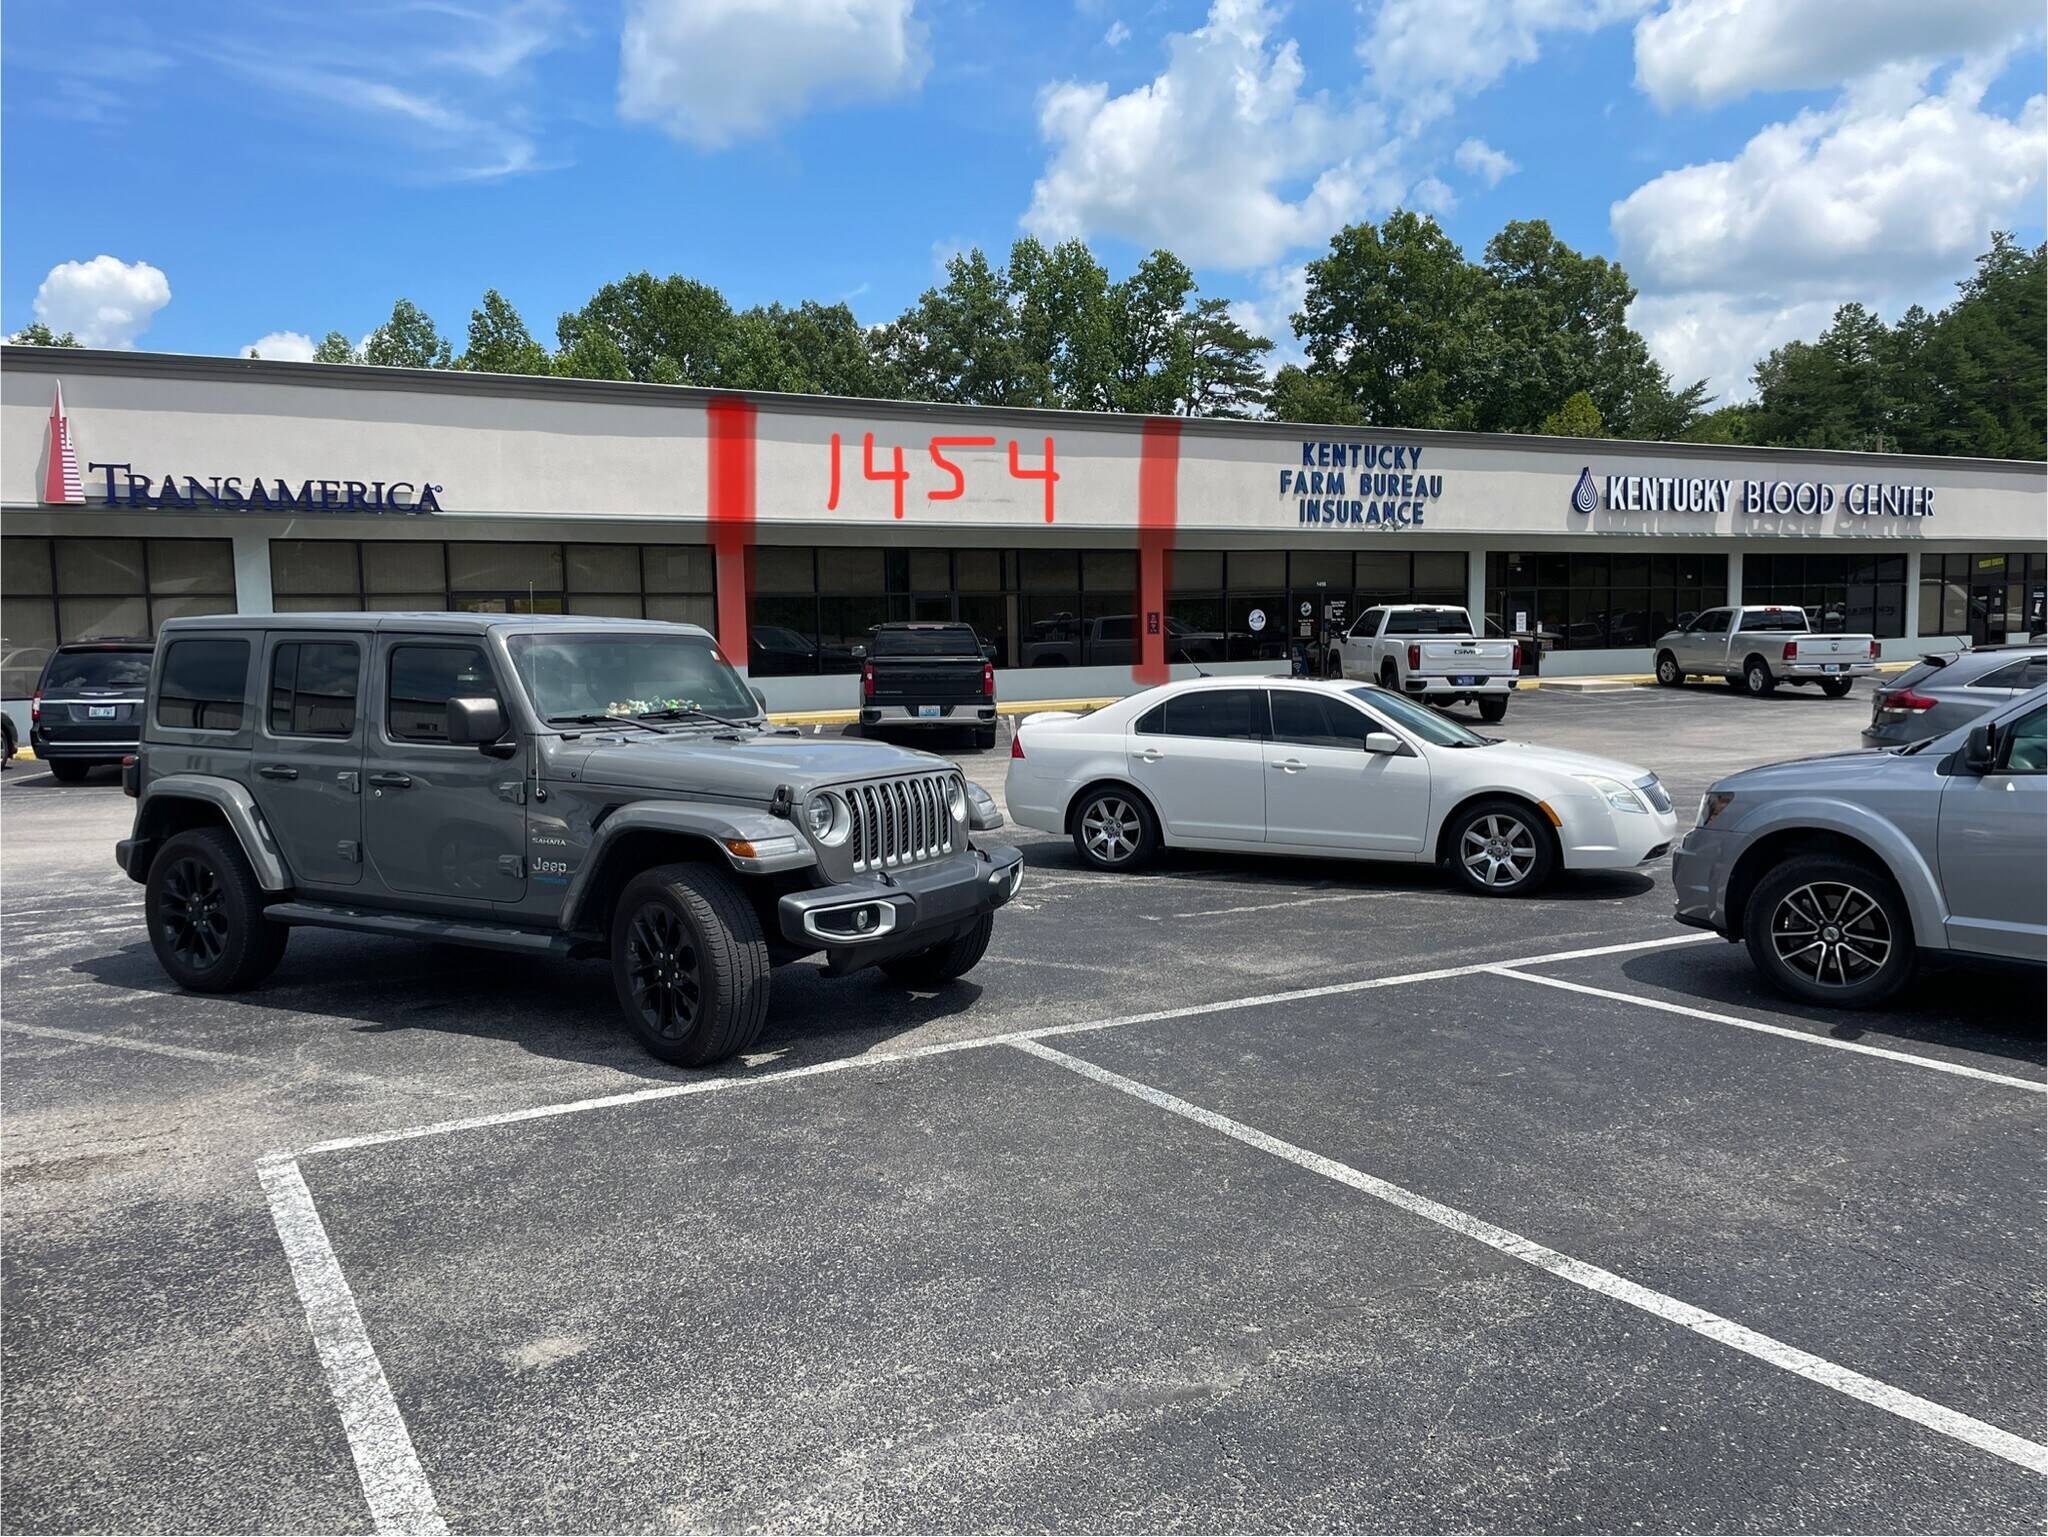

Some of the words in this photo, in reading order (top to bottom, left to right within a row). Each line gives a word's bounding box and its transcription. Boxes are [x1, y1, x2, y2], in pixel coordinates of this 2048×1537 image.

[1302, 442, 1424, 470] KENTUCKY
[88, 462, 444, 513] TRANSAMERICA
[1279, 470, 1346, 495] FARM
[1359, 473, 1443, 499] BUREAU
[1605, 475, 1734, 513] KENTUCKY
[1743, 480, 1836, 515] BLOOD
[1846, 483, 1937, 517] CENTER
[1299, 499, 1424, 525] INSURANCE
[532, 857, 568, 876] Jeep
